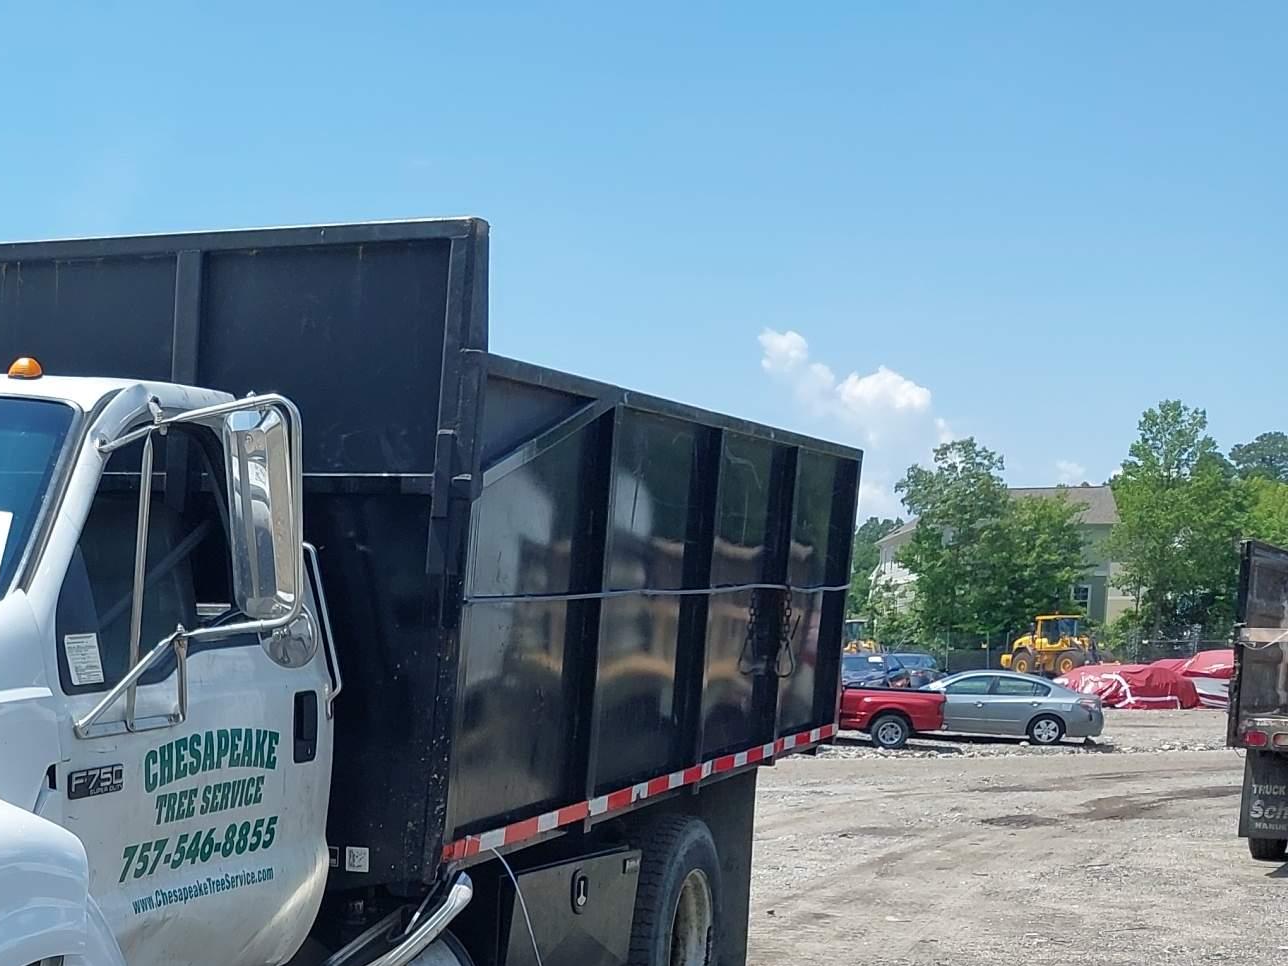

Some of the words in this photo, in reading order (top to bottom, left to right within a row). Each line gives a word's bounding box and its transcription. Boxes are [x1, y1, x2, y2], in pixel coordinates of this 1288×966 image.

[144, 728, 280, 793] CHESAPEAKE
[155, 788, 198, 825] TREE
[200, 776, 265, 815] SERVICE
[1252, 784, 1287, 796] TRUCK
[119, 815, 279, 883] 757-546-8855
[132, 866, 274, 915] www.ChesapeakeTreeService.com
